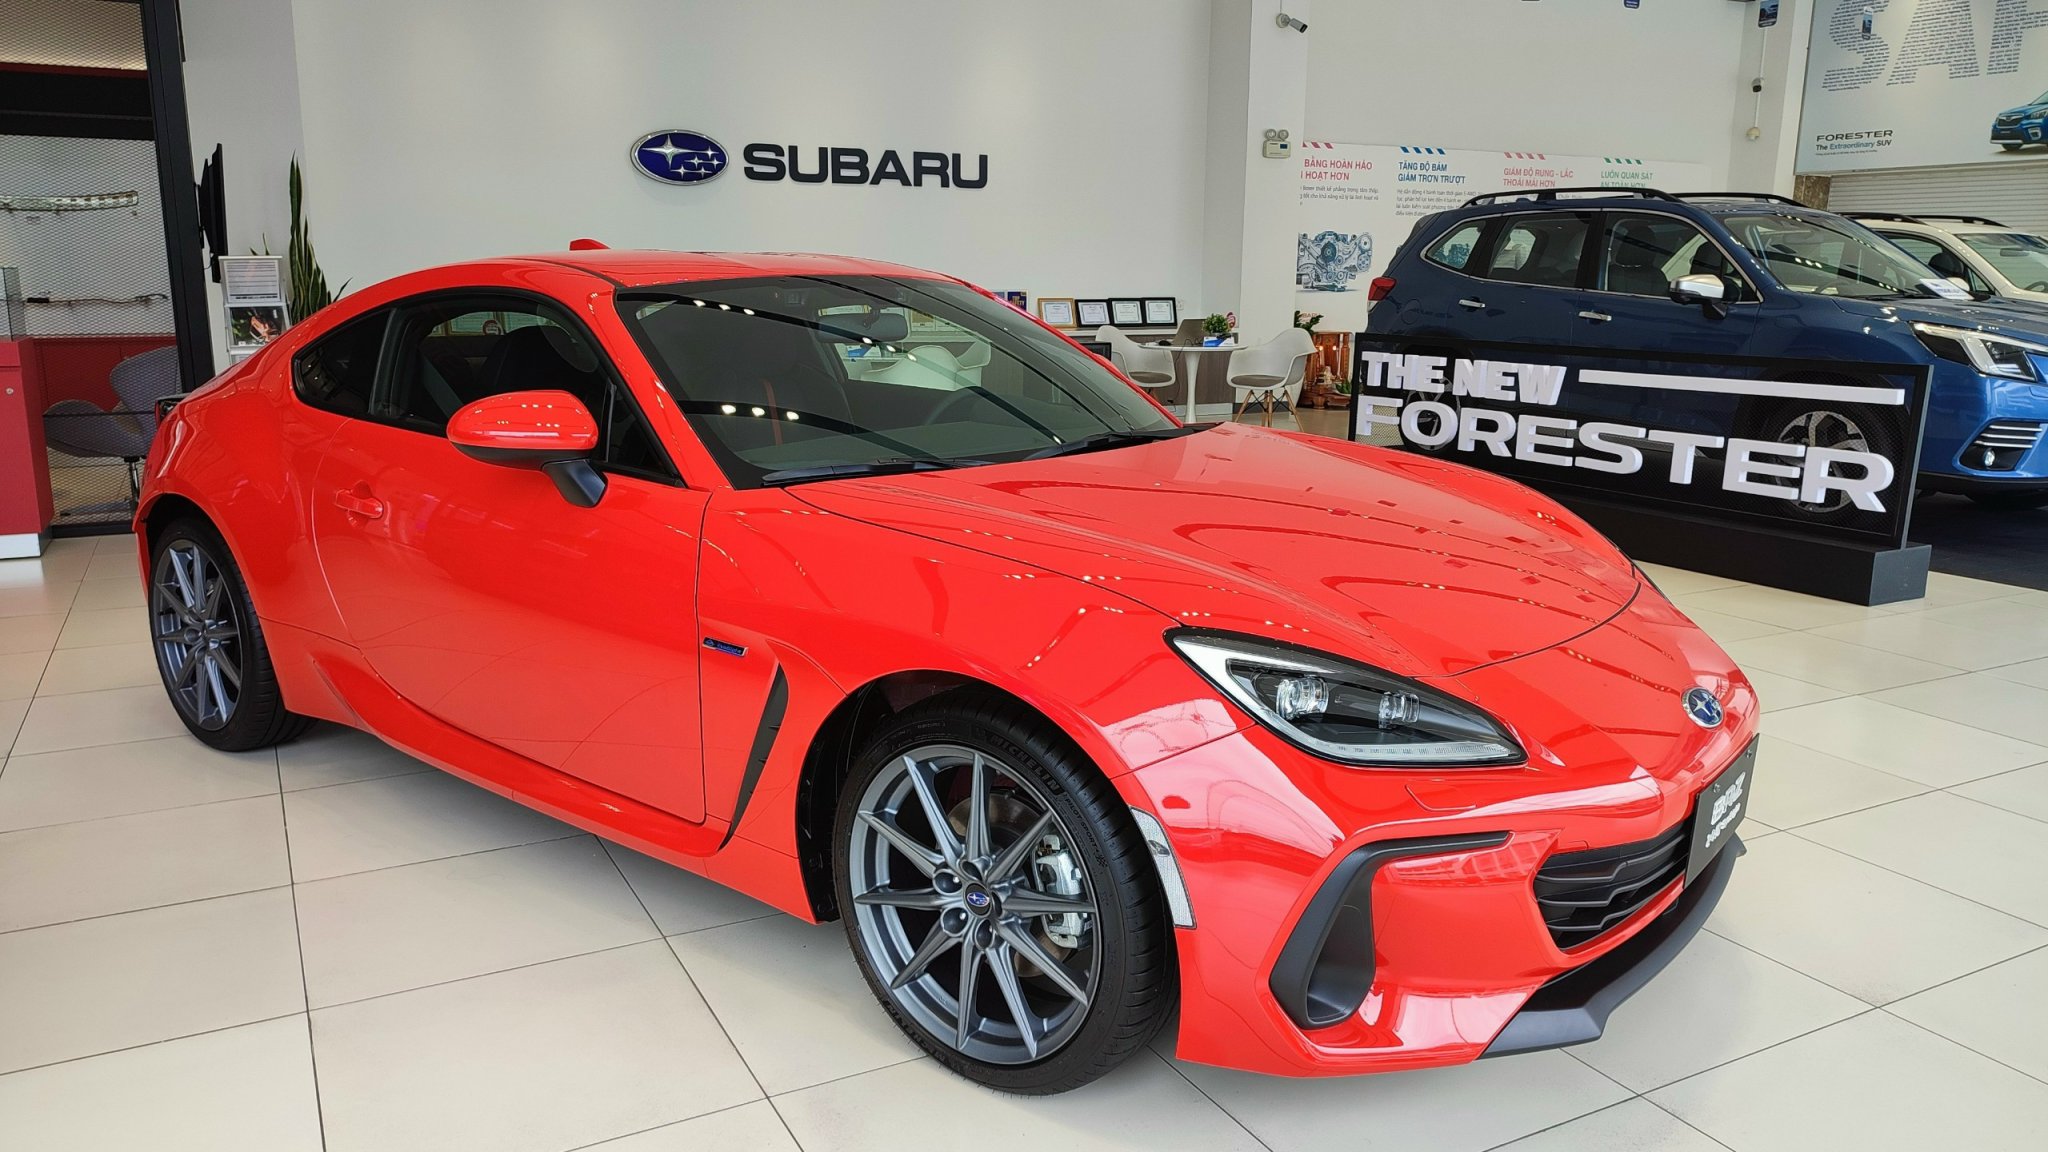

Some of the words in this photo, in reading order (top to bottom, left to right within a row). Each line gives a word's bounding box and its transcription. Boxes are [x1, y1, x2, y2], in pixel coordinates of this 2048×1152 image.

[1816, 129, 1894, 142] FORESTER
[1829, 141, 1876, 150] Extraordinary
[1876, 139, 1892, 147] SUV
[743, 143, 988, 189] SUBARU
[1399, 160, 1418, 171] TĂNG
[1419, 160, 1431, 173] ĐỘ
[1305, 170, 1328, 182] HOẠT
[1330, 171, 1350, 181] HƠN
[1534, 169, 1554, 177] RUNG
[1620, 171, 1640, 180] QUAN
[1418, 174, 1439, 183] TRƠN
[1440, 175, 1466, 186] TRƯỢT
[1361, 351, 1447, 393] THE
[1452, 358, 1567, 406] NEW
[1355, 394, 1894, 513] FORESTER
